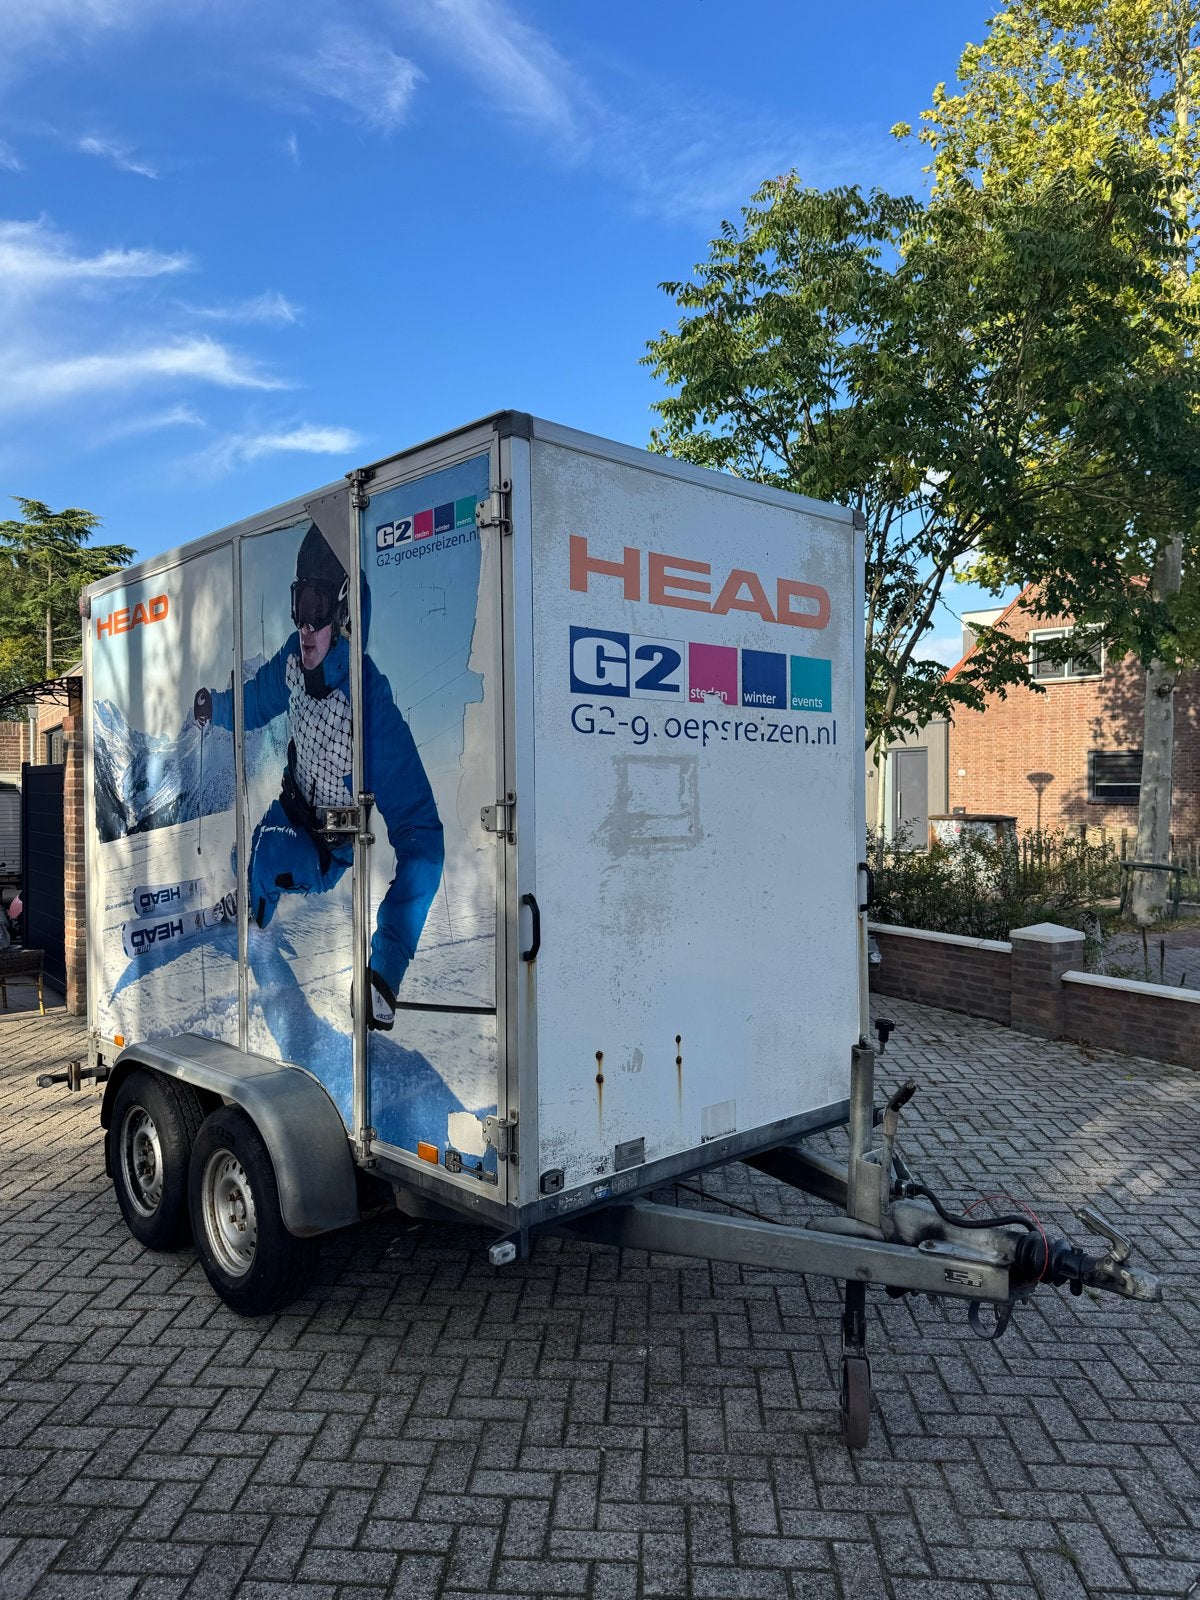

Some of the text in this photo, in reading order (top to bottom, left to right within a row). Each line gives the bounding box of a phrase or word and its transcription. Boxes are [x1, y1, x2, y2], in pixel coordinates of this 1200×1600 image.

[376, 526, 480, 567] G2-groepsreizen.nl
[377, 517, 473, 548] G2 steden winter events
[569, 534, 832, 630] HEAD
[96, 594, 169, 641] HEAD
[572, 636, 682, 693] G2
[743, 691, 777, 705] winter
[791, 696, 823, 709] events
[571, 703, 837, 747] G2-goepsreizen.nl
[139, 886, 181, 907] HEAD
[131, 918, 184, 948] HEAD
